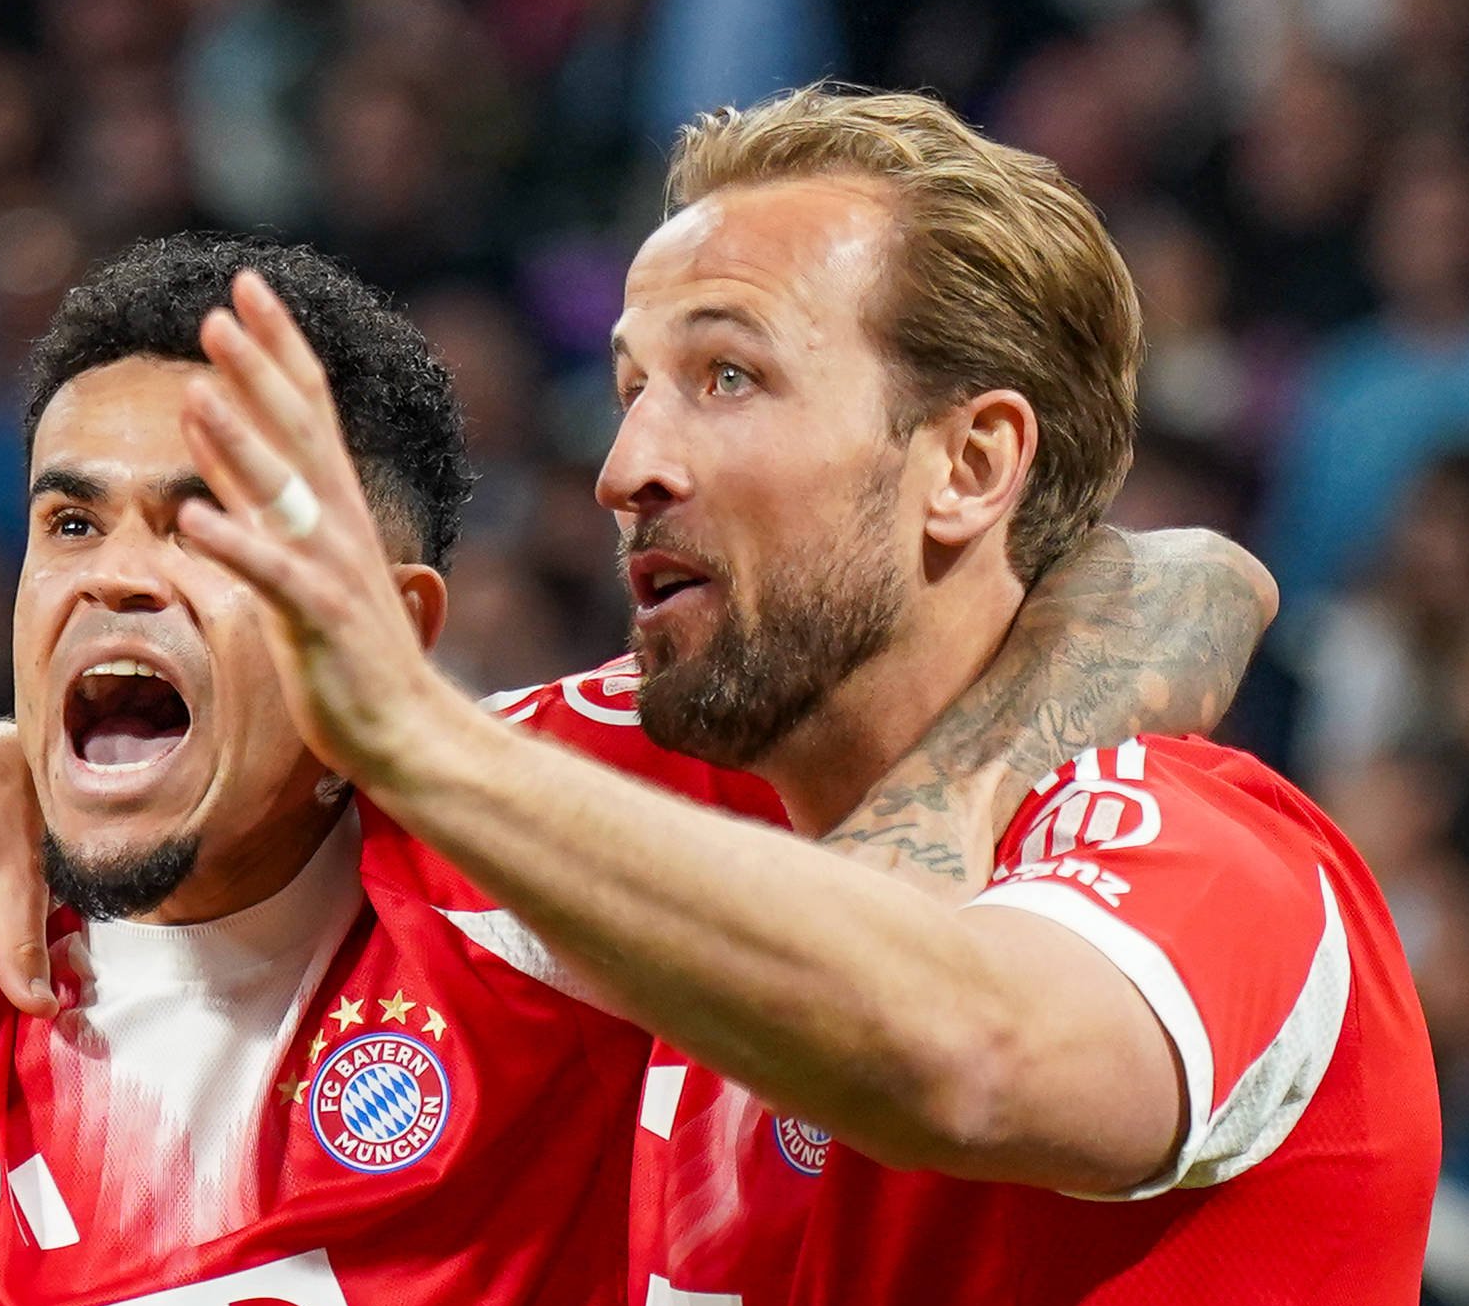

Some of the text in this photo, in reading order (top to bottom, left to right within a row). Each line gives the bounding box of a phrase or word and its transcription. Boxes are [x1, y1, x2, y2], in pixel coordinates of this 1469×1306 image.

[320, 1042, 430, 1112] FC BAYERN
[334, 1097, 440, 1164] MÜNCHEN
